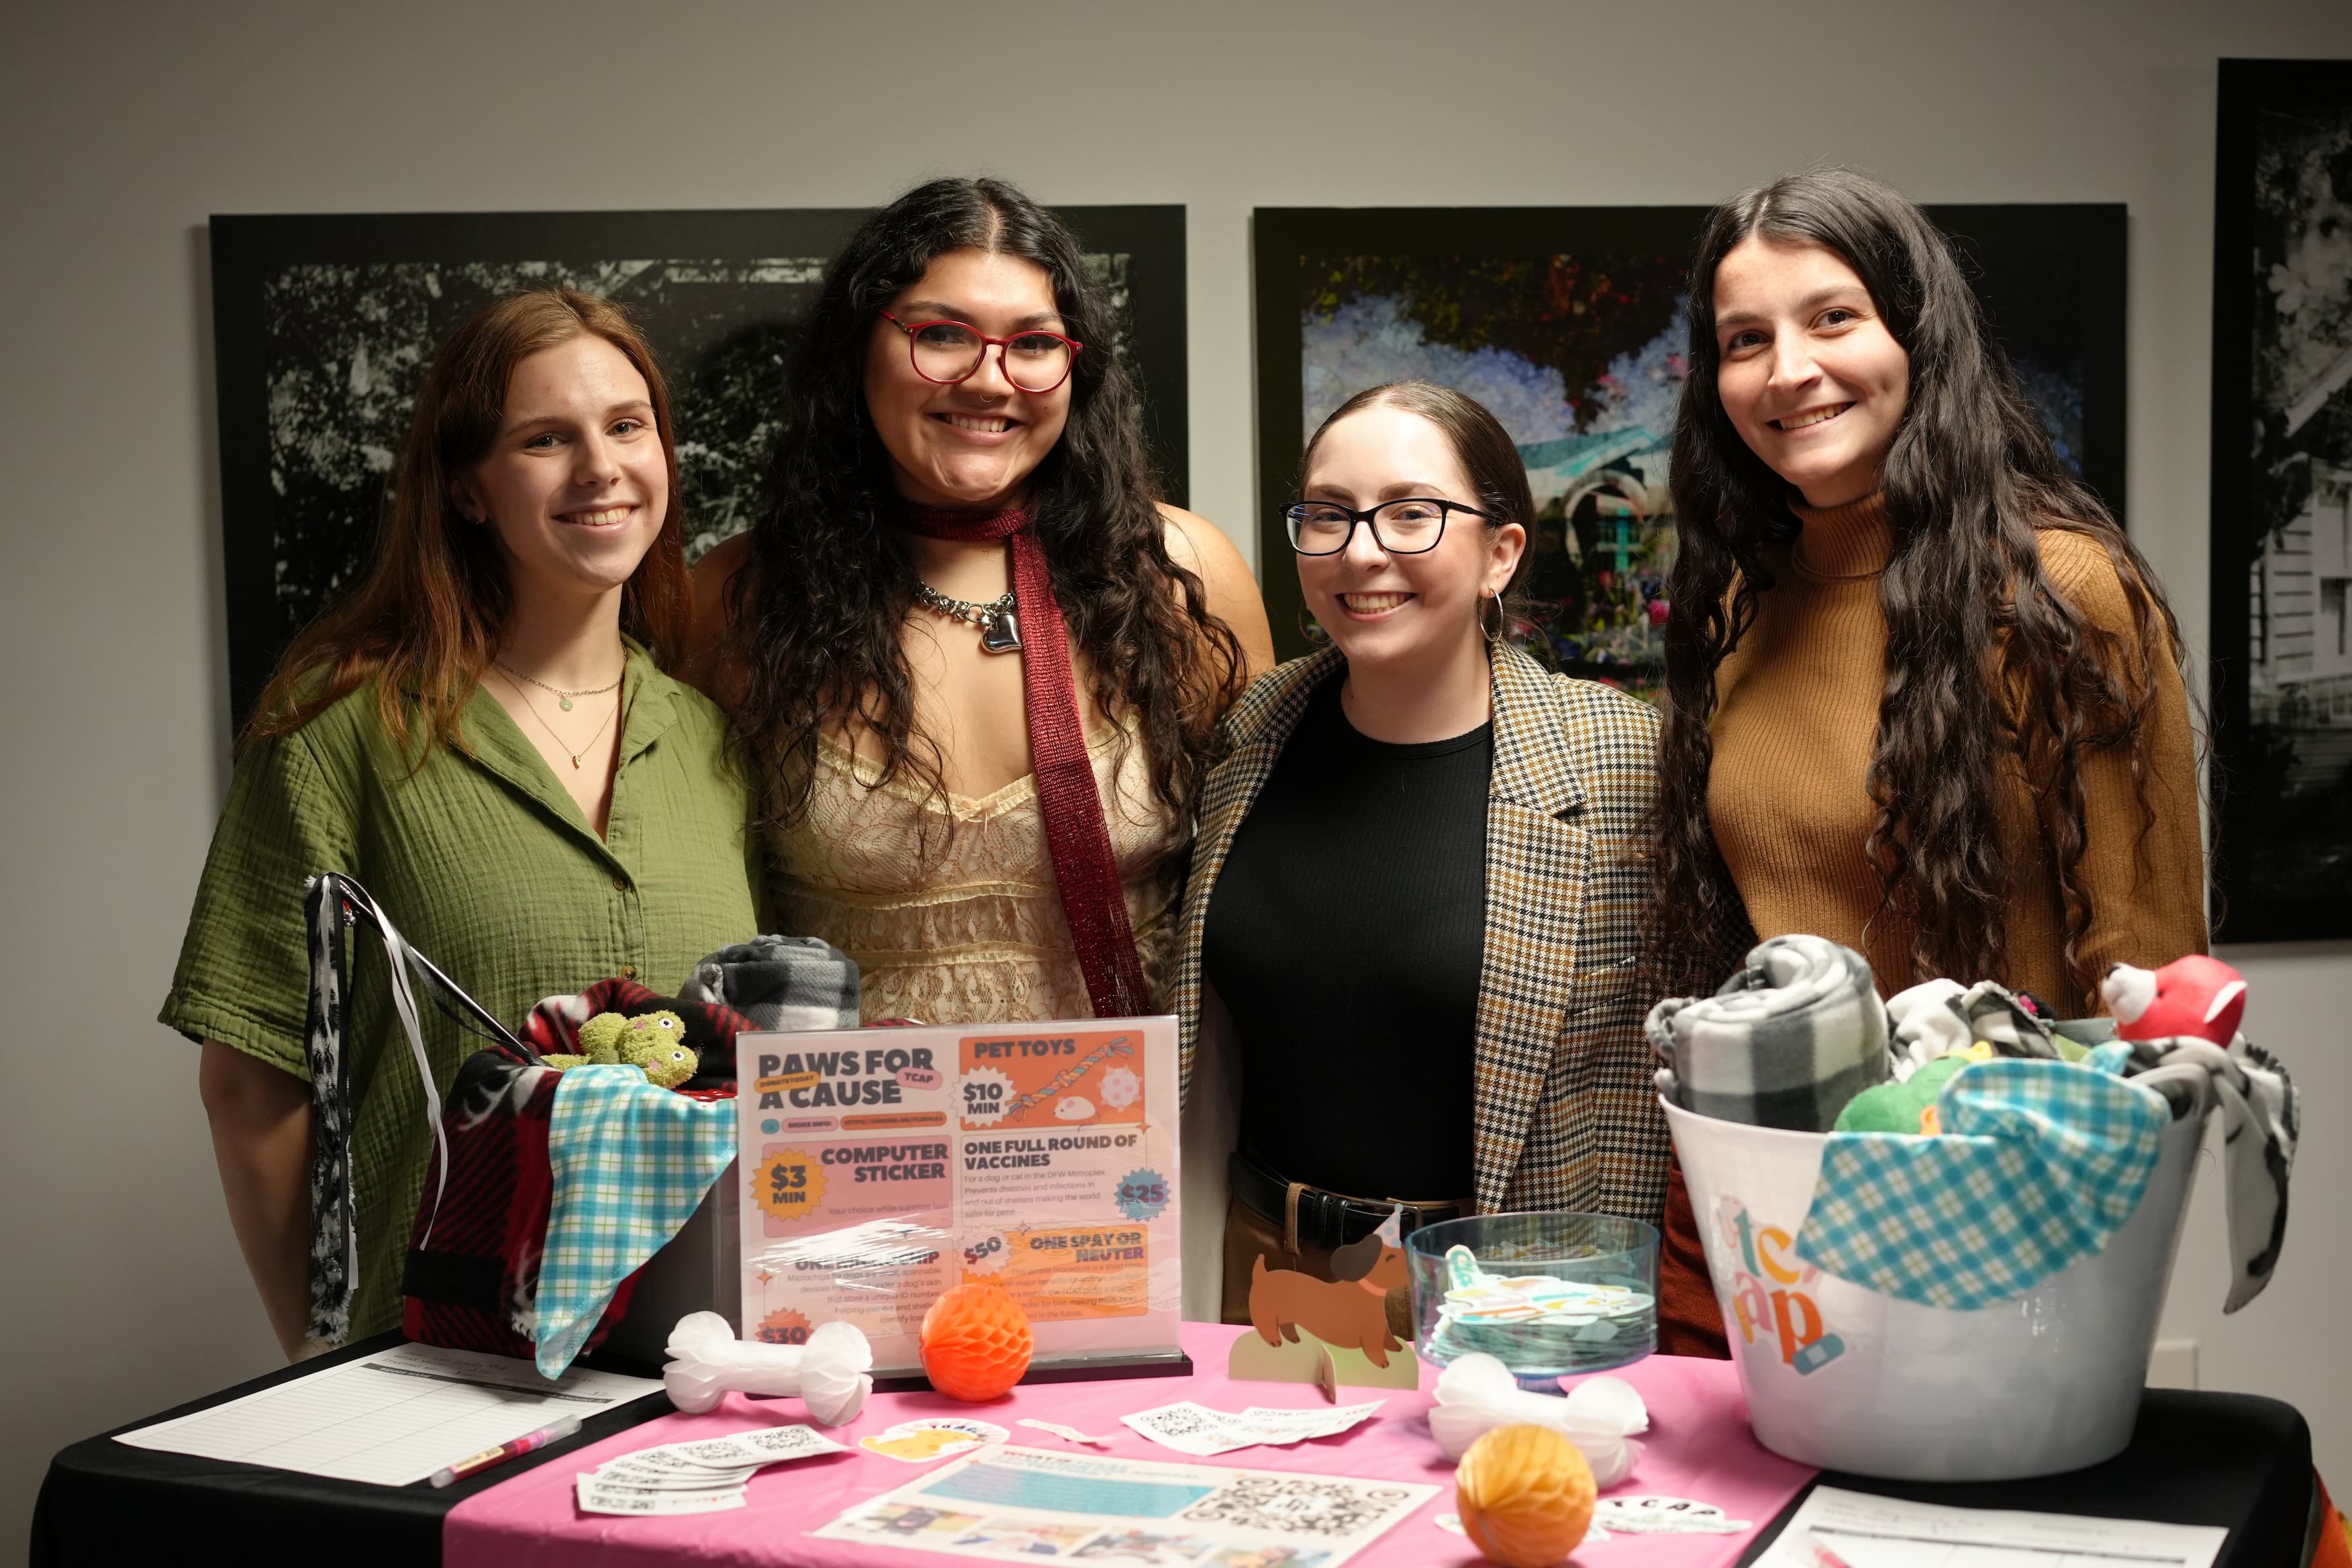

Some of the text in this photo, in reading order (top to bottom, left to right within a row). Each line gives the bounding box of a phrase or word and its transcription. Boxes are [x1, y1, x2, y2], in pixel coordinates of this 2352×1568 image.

[975, 1039, 1076, 1059] PET TOYS
[758, 1048, 934, 1078] PAWS FOR
[904, 1073, 934, 1083] TCAP
[758, 1080, 902, 1110] A CAUSE
[963, 1082, 1003, 1103] $10
[967, 1102, 999, 1114] MIN
[965, 1134, 1137, 1155] ONE FULL ROUND OF
[821, 1143, 948, 1165] COMPUTER
[965, 1154, 1050, 1170] VACCINES
[770, 1163, 807, 1191] $3
[854, 1163, 946, 1182] STICKER
[985, 1175, 999, 1183] dog
[1047, 1171, 1066, 1179] DFW
[965, 1186, 997, 1194] Prevents
[1033, 1183, 1047, 1191] and
[1049, 1181, 1086, 1189] infections
[1121, 1184, 1164, 1202] $25
[773, 1191, 805, 1204] MIN
[1004, 1195, 1034, 1204] shelters
[1035, 1195, 1063, 1204] making
[828, 1208, 846, 1216] Your
[847, 1206, 874, 1214] choice
[876, 1205, 897, 1213] while
[899, 1203, 931, 1213] supplies
[1030, 1232, 1142, 1250] ONE SPAY OR
[964, 1236, 1001, 1265] $50
[1076, 1246, 1144, 1262] NEUTER
[901, 1267, 942, 1275] scannable
[1052, 1265, 1091, 1274] procedure
[801, 1285, 830, 1293] devices
[903, 1279, 925, 1289] dog's
[926, 1278, 942, 1286] skin
[871, 1293, 898, 1302] unique
[899, 1291, 908, 1299] ID
[835, 1306, 864, 1315] helping
[895, 1303, 911, 1311] and
[881, 1315, 908, 1324] identify
[762, 1326, 807, 1344] $30
